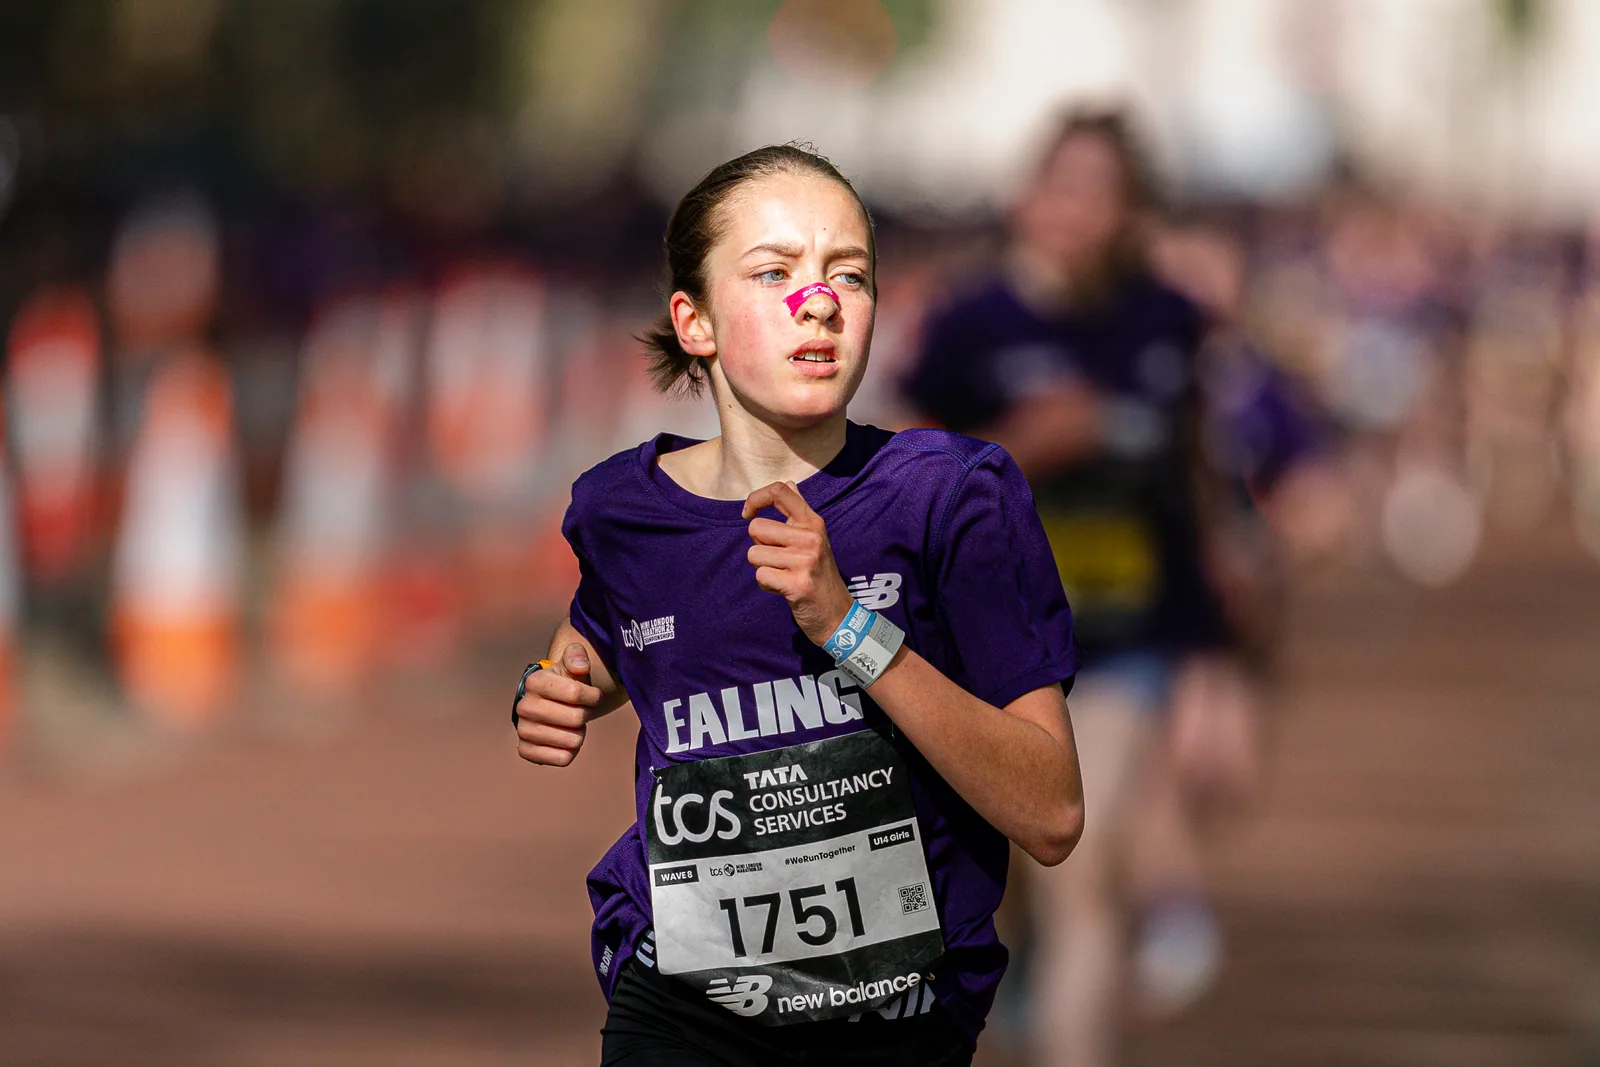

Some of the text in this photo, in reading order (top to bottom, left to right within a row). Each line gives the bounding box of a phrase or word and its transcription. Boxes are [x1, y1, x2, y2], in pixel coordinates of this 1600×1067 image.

[663, 669, 863, 754] EALING
[743, 763, 808, 790] TATA
[749, 766, 894, 813] CONSULTANCY
[653, 783, 742, 846] tcs
[753, 802, 848, 836] SERVICES
[784, 844, 857, 866] #WeRunTogether
[873, 831, 910, 846] U14 Girls
[660, 870, 693, 882] WAVE 8
[709, 867, 724, 877] tcs
[718, 876, 866, 959] 1751
[777, 991, 823, 1014] new
[828, 972, 921, 1008] balance
